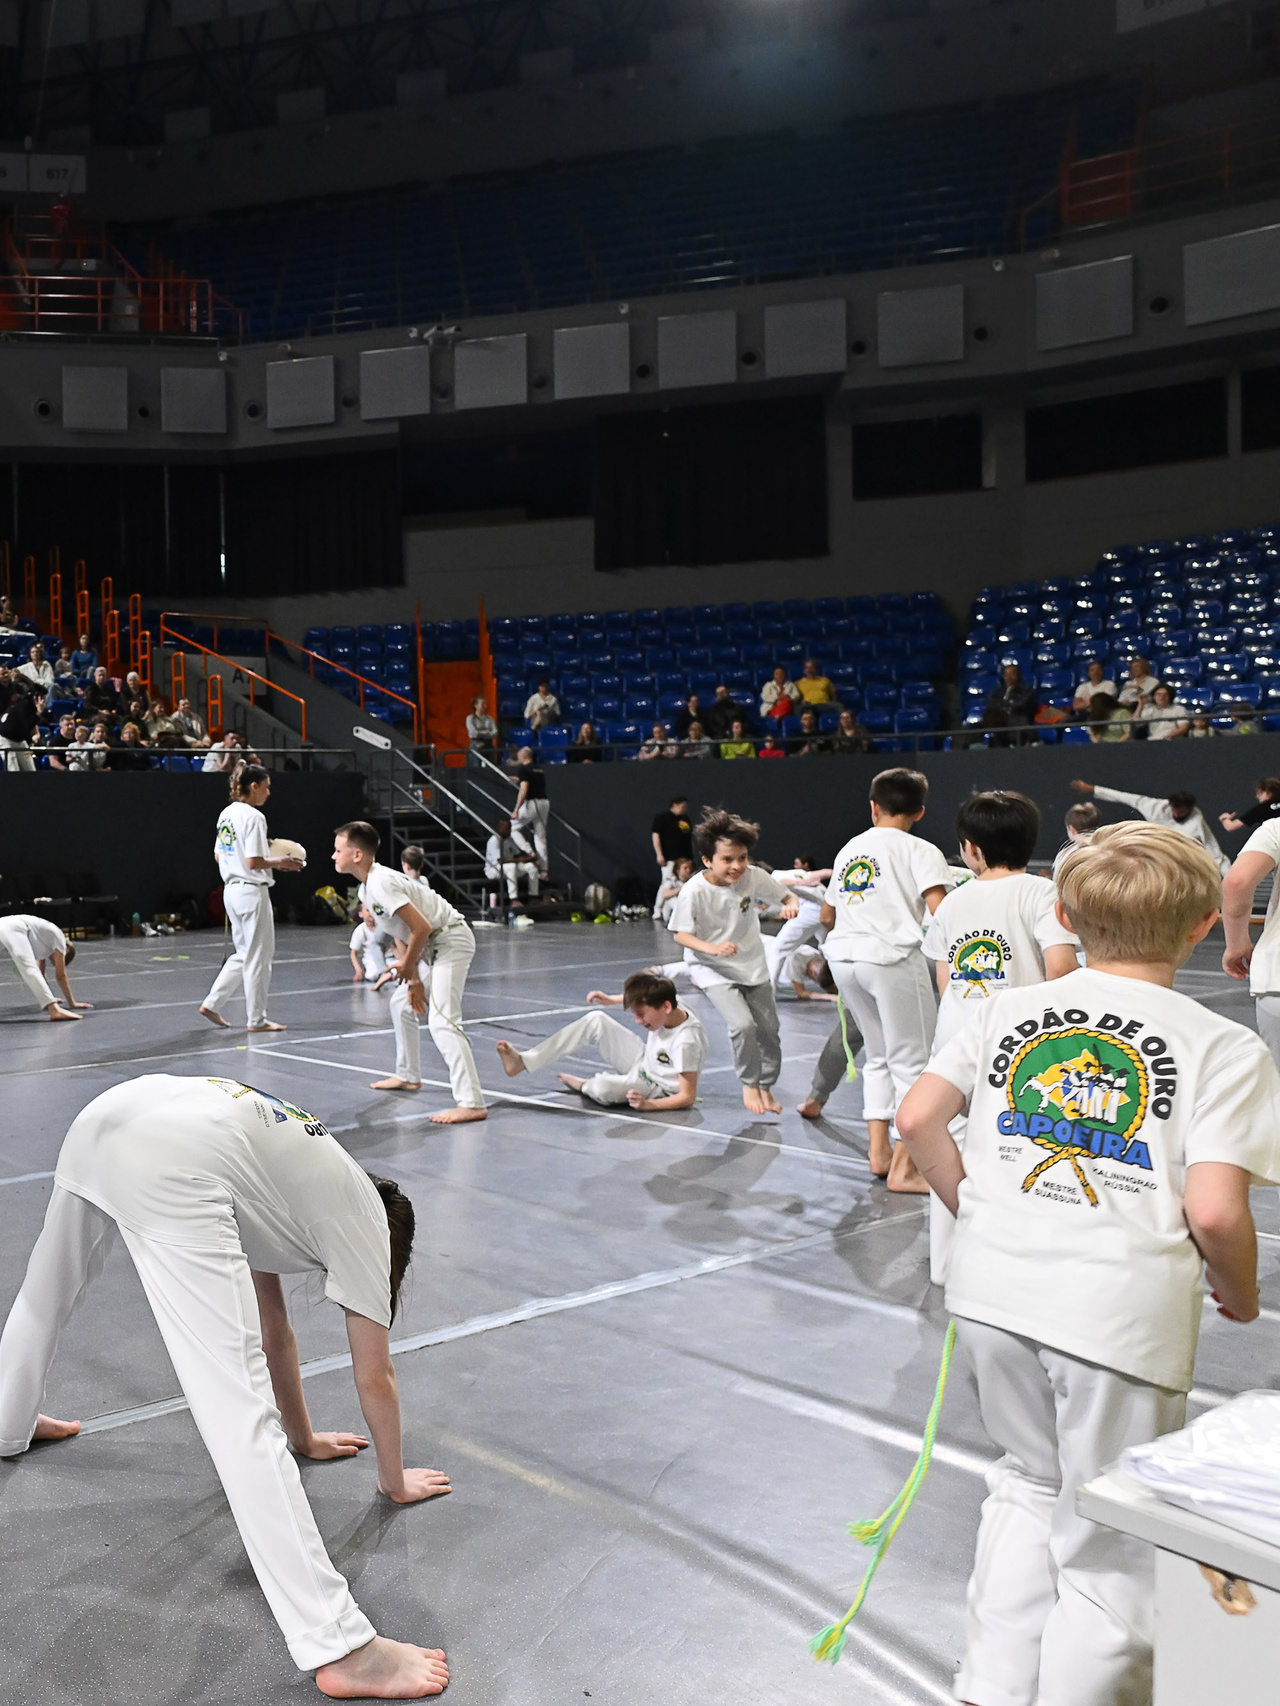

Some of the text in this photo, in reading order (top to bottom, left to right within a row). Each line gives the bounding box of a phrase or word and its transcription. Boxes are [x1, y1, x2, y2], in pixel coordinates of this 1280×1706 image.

[982, 929, 996, 938] DE
[996, 934, 1013, 962] OURO
[988, 1007, 1178, 1121] CORDÃO DE OURO
[997, 1110, 1154, 1171] CAPOEIRA
[1042, 1180, 1078, 1196] MESTRE
